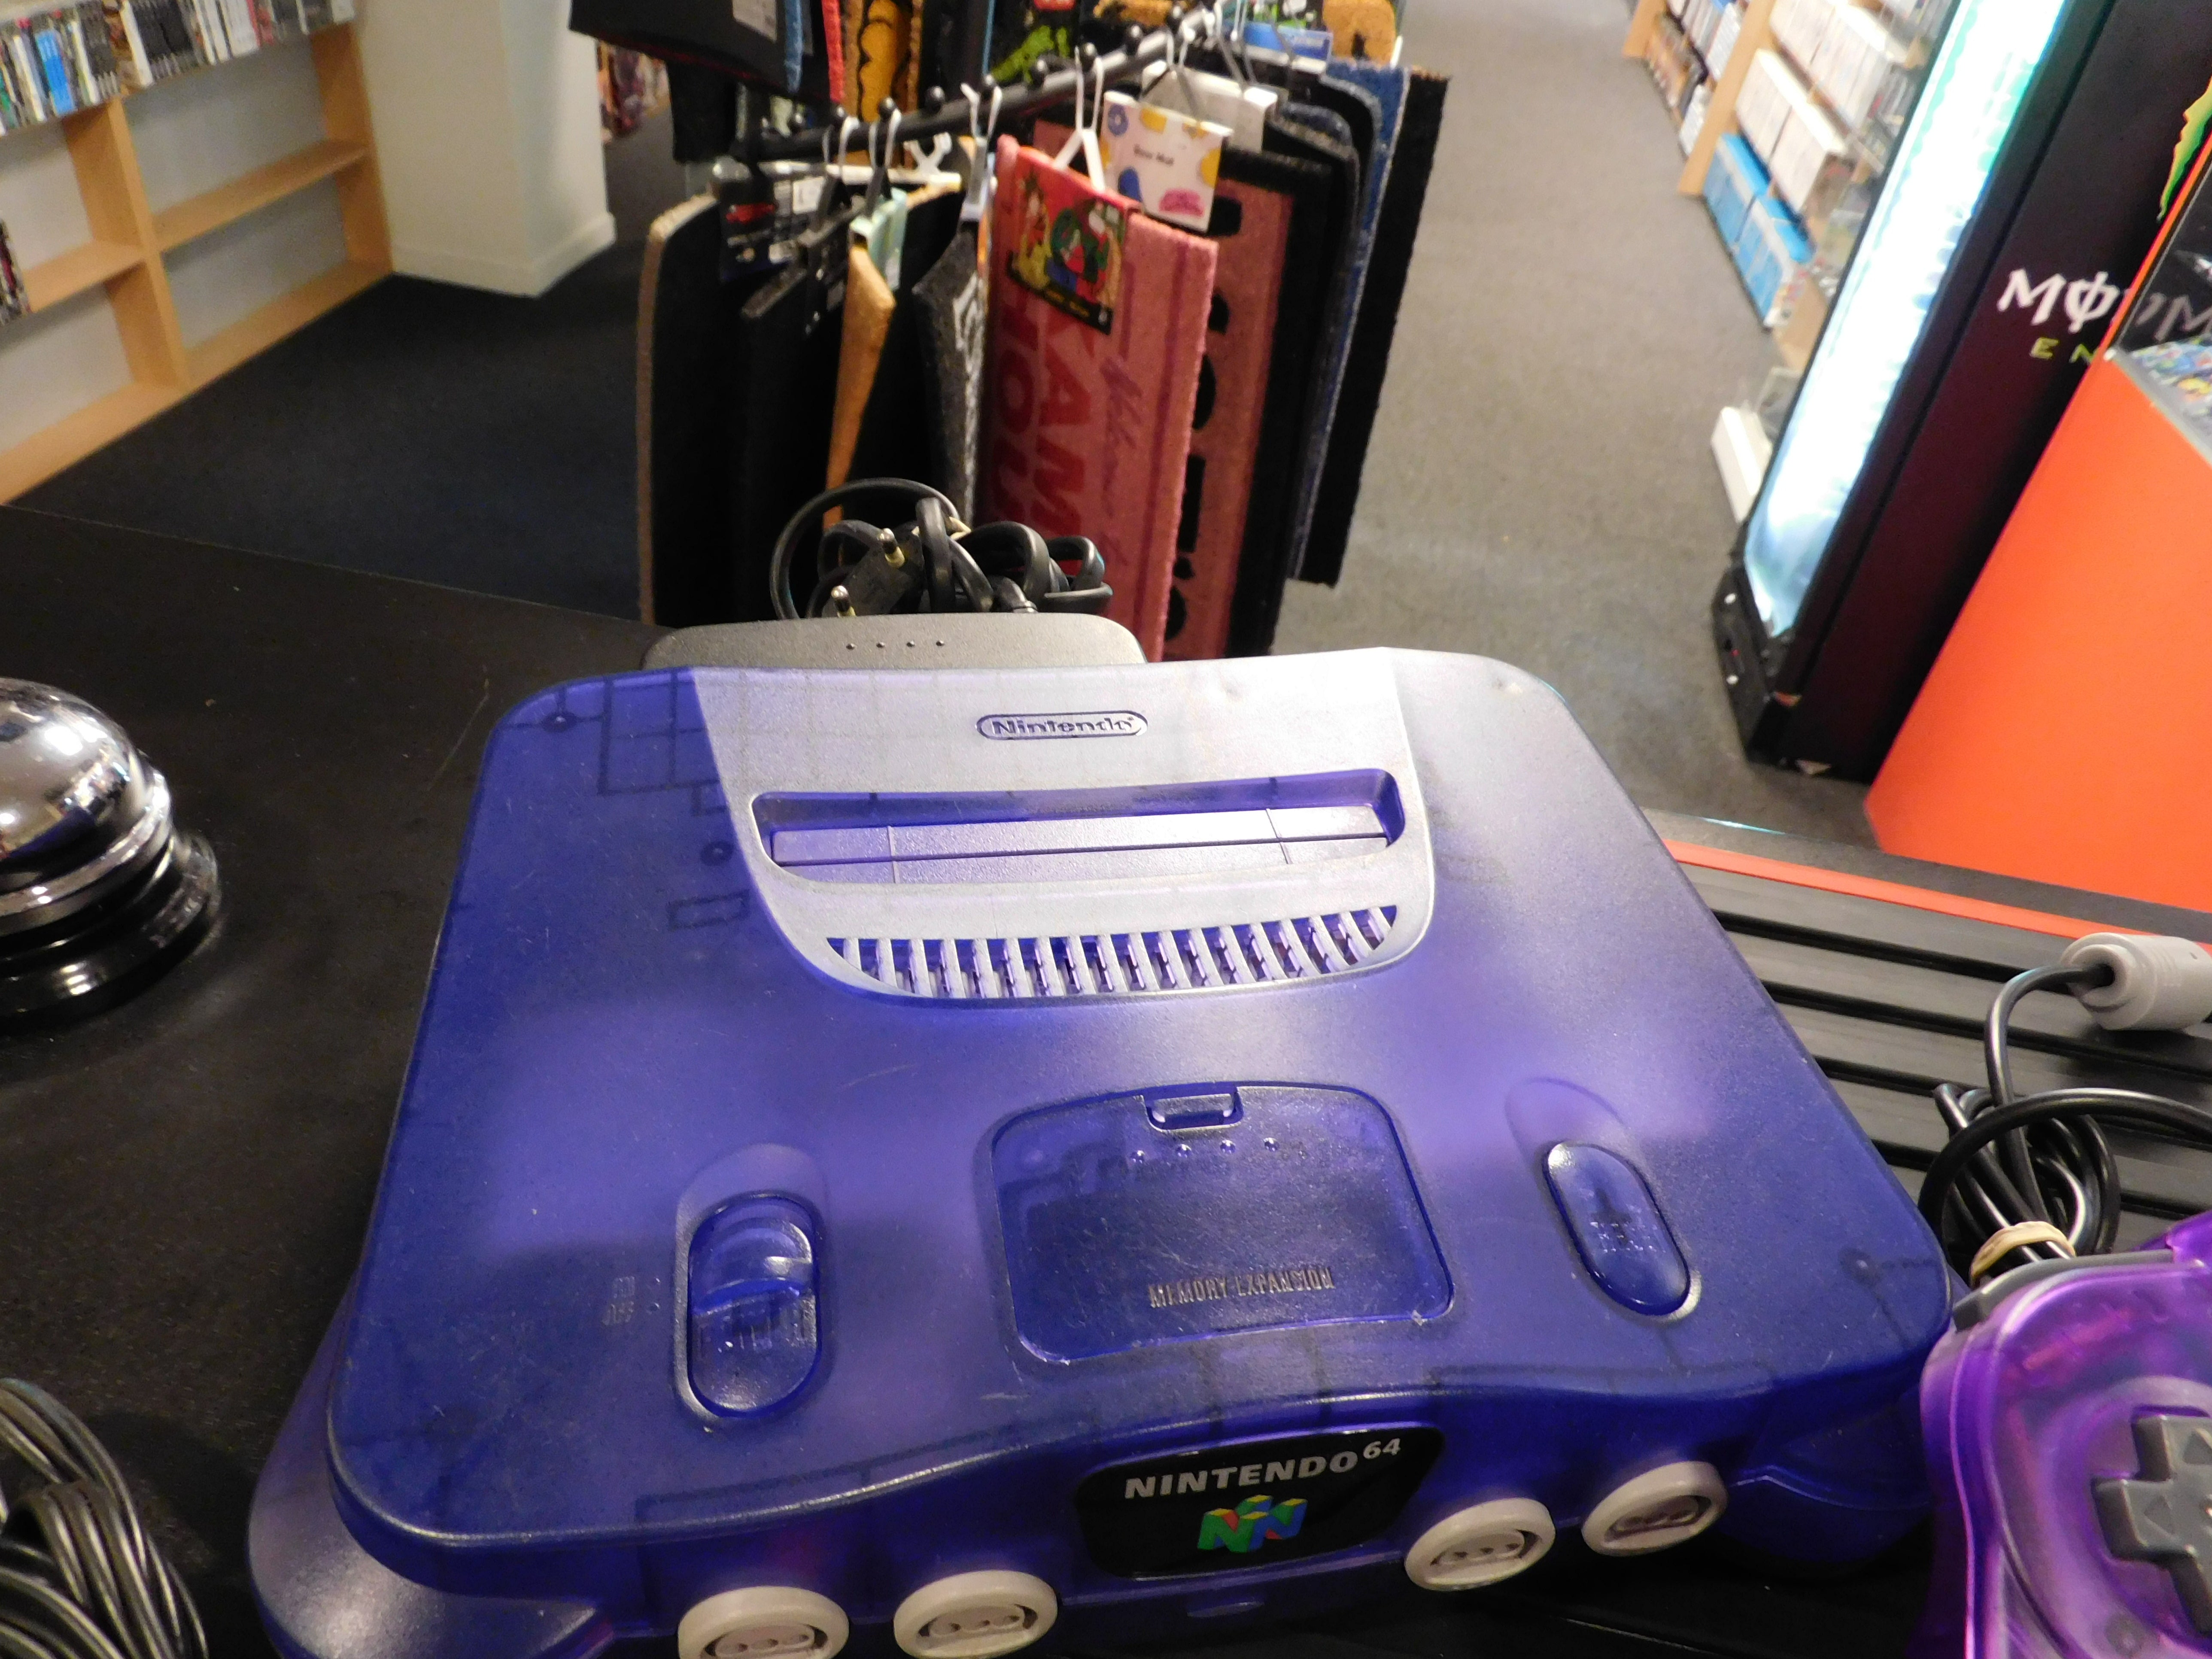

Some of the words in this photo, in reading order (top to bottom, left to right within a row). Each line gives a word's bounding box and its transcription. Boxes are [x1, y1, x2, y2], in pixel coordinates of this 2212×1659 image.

[991, 717, 1132, 735] Nintendo
[1149, 1277, 1228, 1308] MEMORY
[1235, 1266, 1335, 1296] EXPANSION
[1124, 1451, 1358, 1500] NINTENDO
[1363, 1437, 1402, 1460] 64
